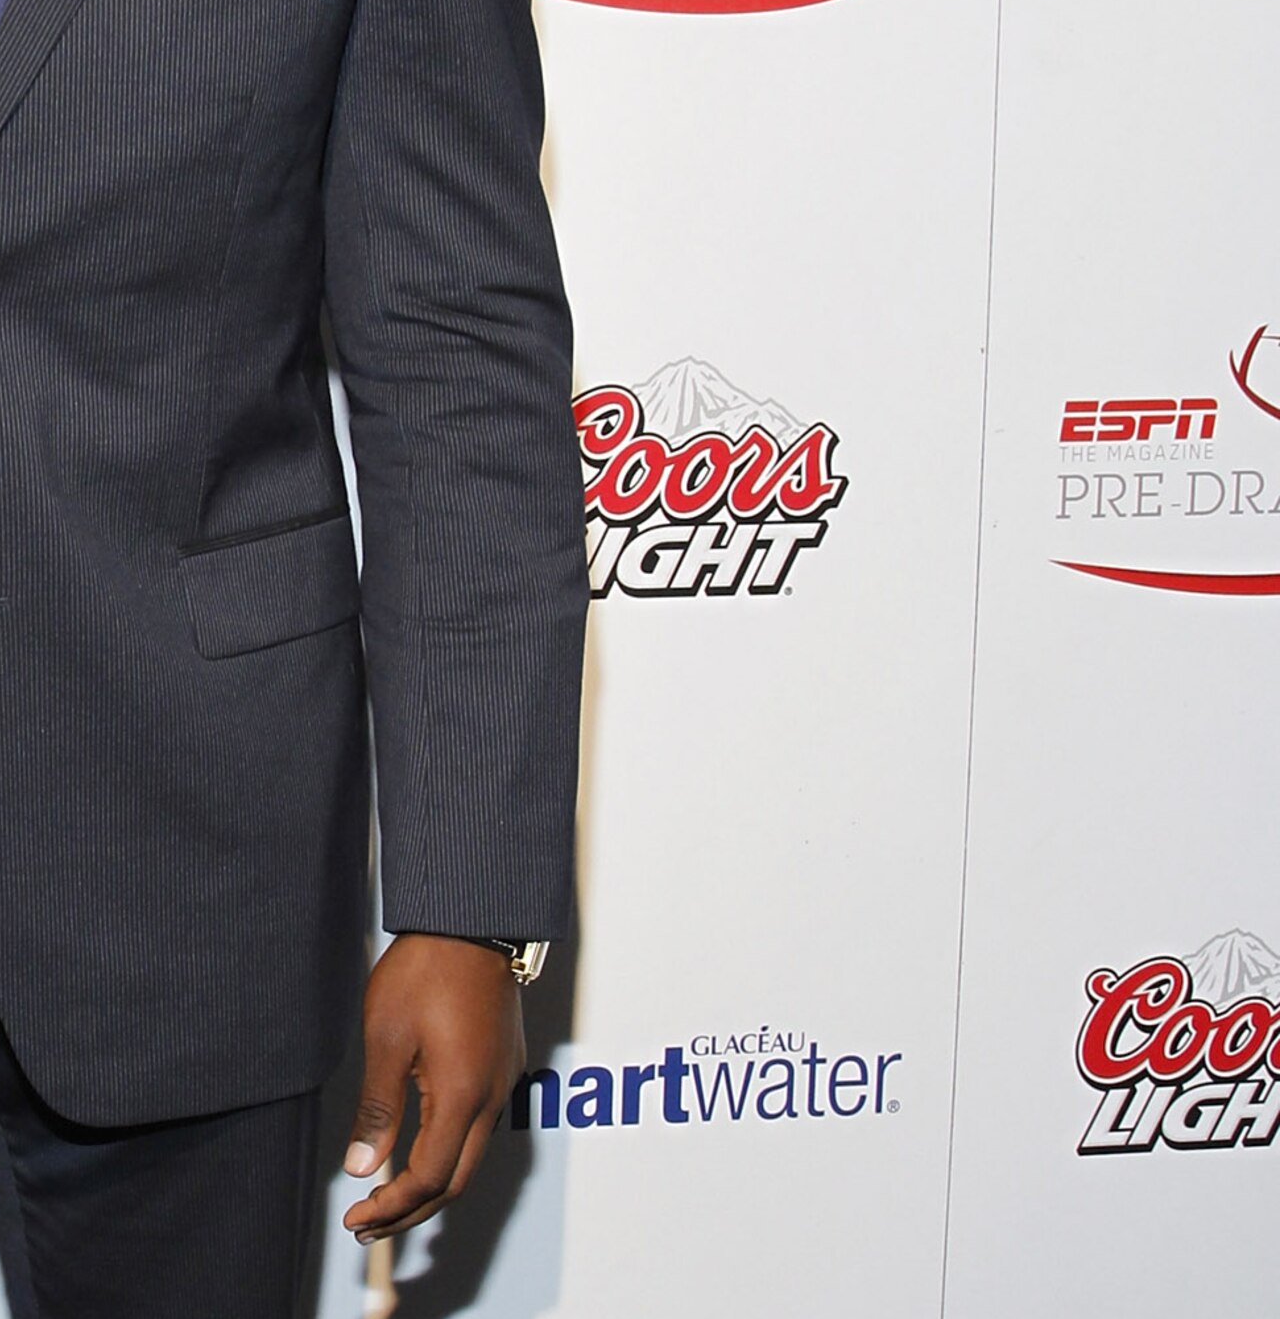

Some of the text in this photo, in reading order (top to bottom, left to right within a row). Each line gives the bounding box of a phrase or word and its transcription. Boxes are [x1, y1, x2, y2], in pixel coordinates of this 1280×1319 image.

[1060, 398, 1218, 442] ESPN
[1060, 443, 1214, 462] THE MAGAZINE
[690, 1025, 805, 1056] GLACÉAU
